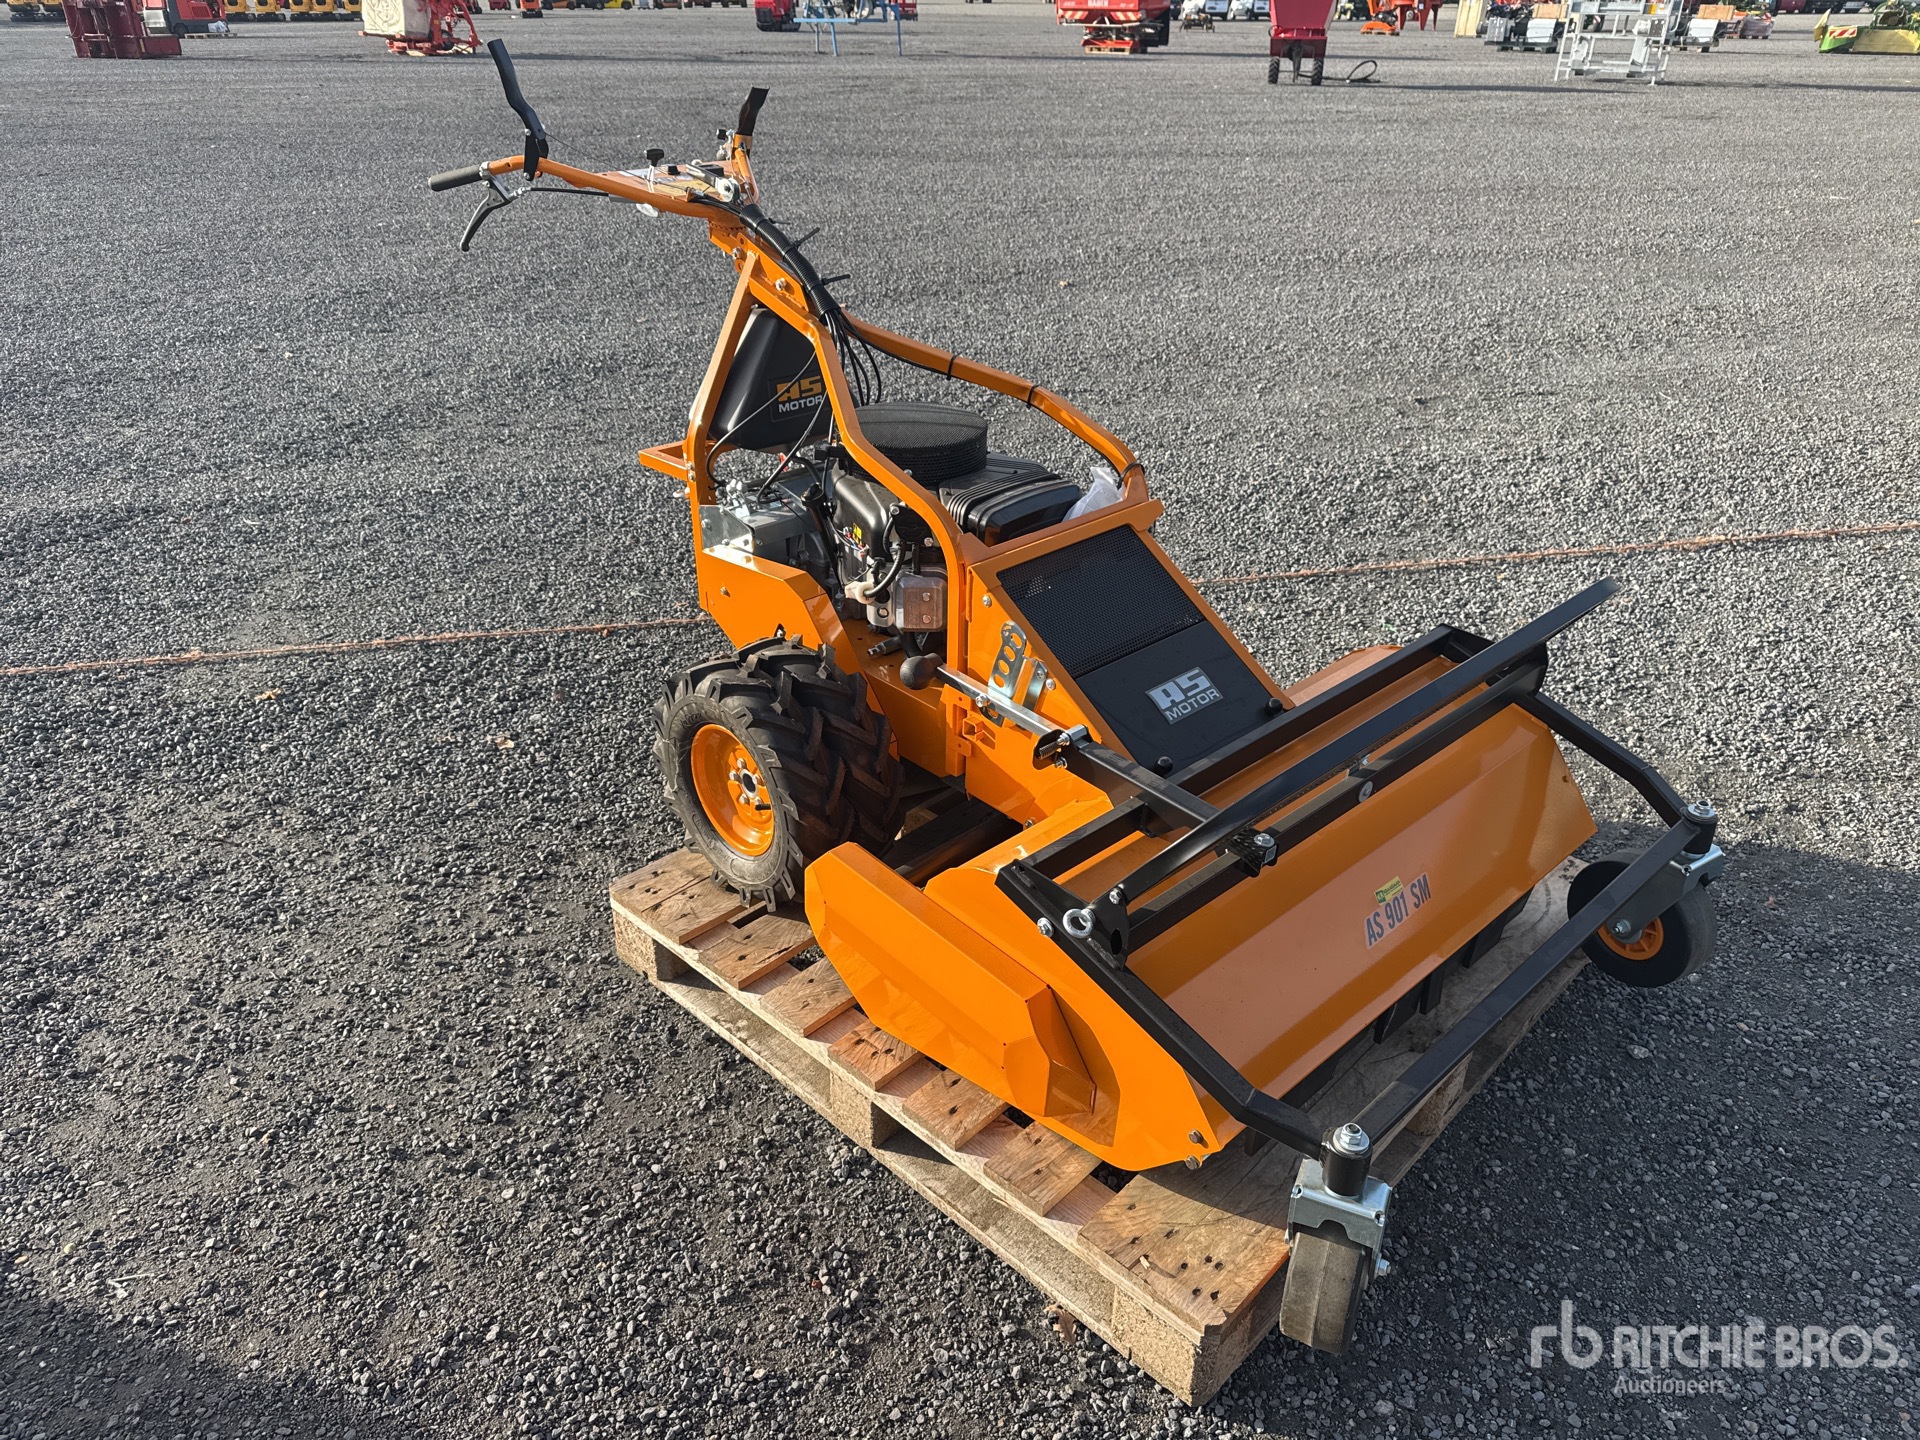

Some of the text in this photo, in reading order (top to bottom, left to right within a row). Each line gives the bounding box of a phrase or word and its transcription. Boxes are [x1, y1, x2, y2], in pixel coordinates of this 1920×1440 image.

[776, 375, 822, 402] AS
[778, 395, 823, 413] MOTOR
[1149, 669, 1211, 710] AS
[1165, 688, 1220, 721] MOTOR
[1366, 911, 1385, 947] AS
[1384, 891, 1409, 930] 901
[1410, 873, 1432, 909] SM
